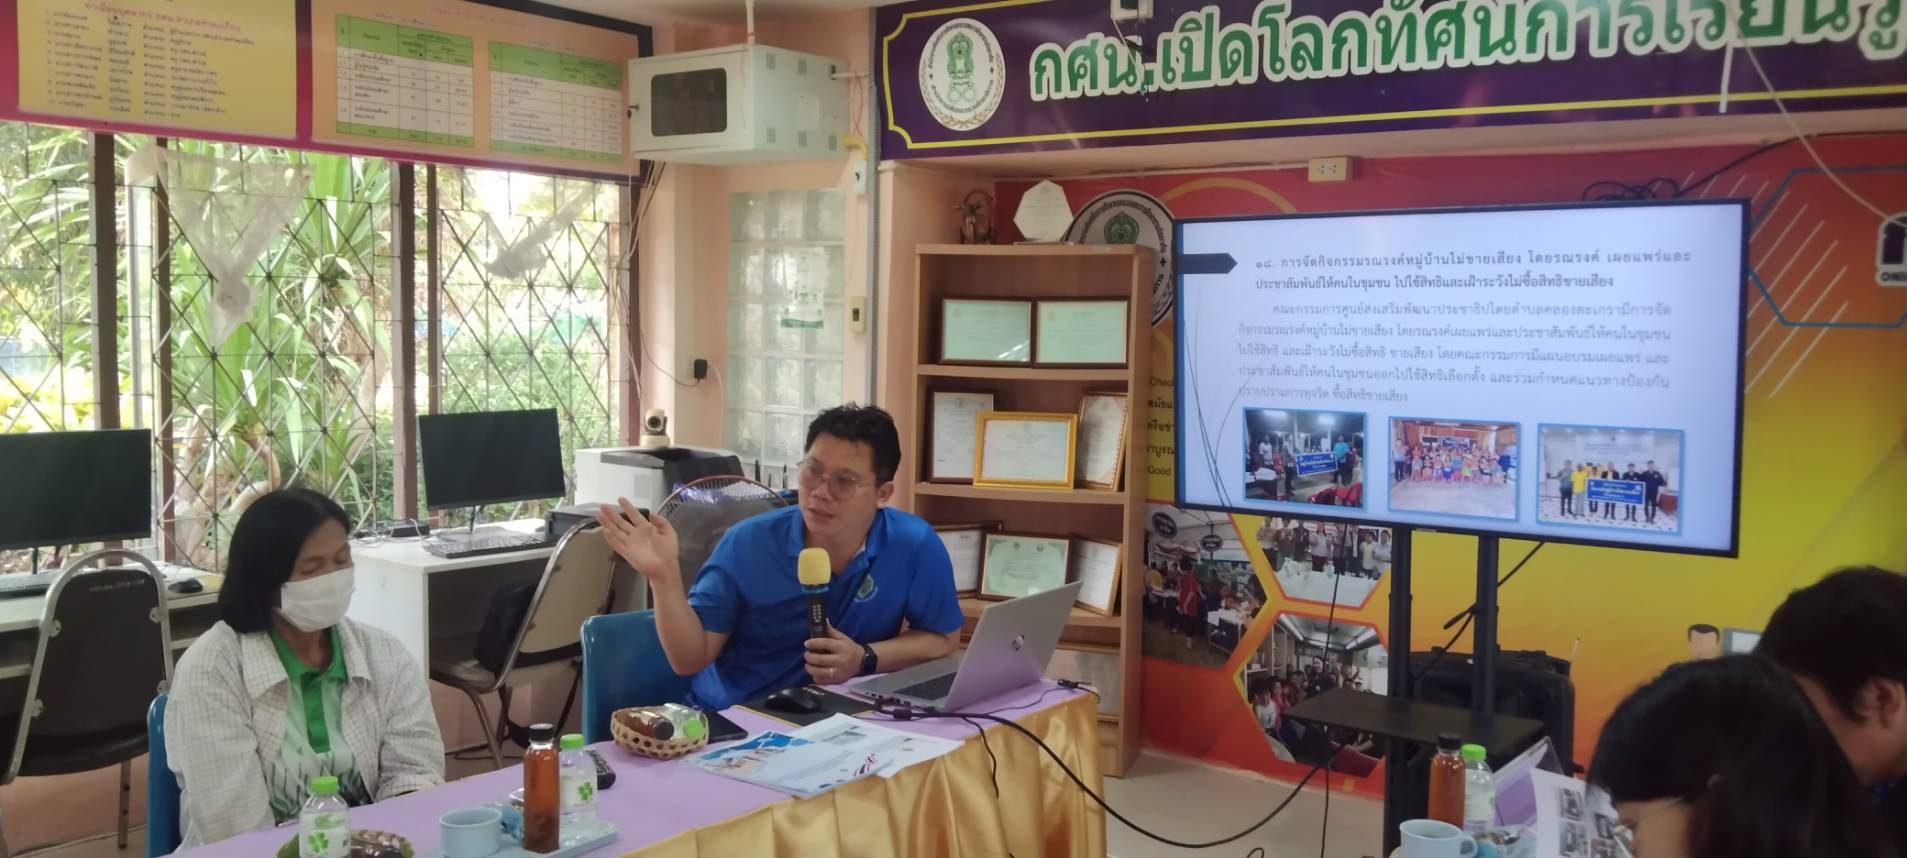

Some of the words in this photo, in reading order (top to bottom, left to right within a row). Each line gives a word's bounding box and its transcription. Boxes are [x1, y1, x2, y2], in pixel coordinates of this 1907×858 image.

[1033, 0, 1900, 96] กศน.เปิดโลกทัศนการเรยนรู
[1281, 250, 1521, 271] การจัดกิจกรรมรณรงค์หมู่บ้านไม่ขายเสียง
[1528, 248, 1600, 264] โดยรณรงค์
[1607, 248, 1691, 263] เผยแพร่และ
[1256, 274, 1390, 291] ประชาสัมพันธ์ให้คนในชุมชน
[1148, 465, 1171, 476] Good
